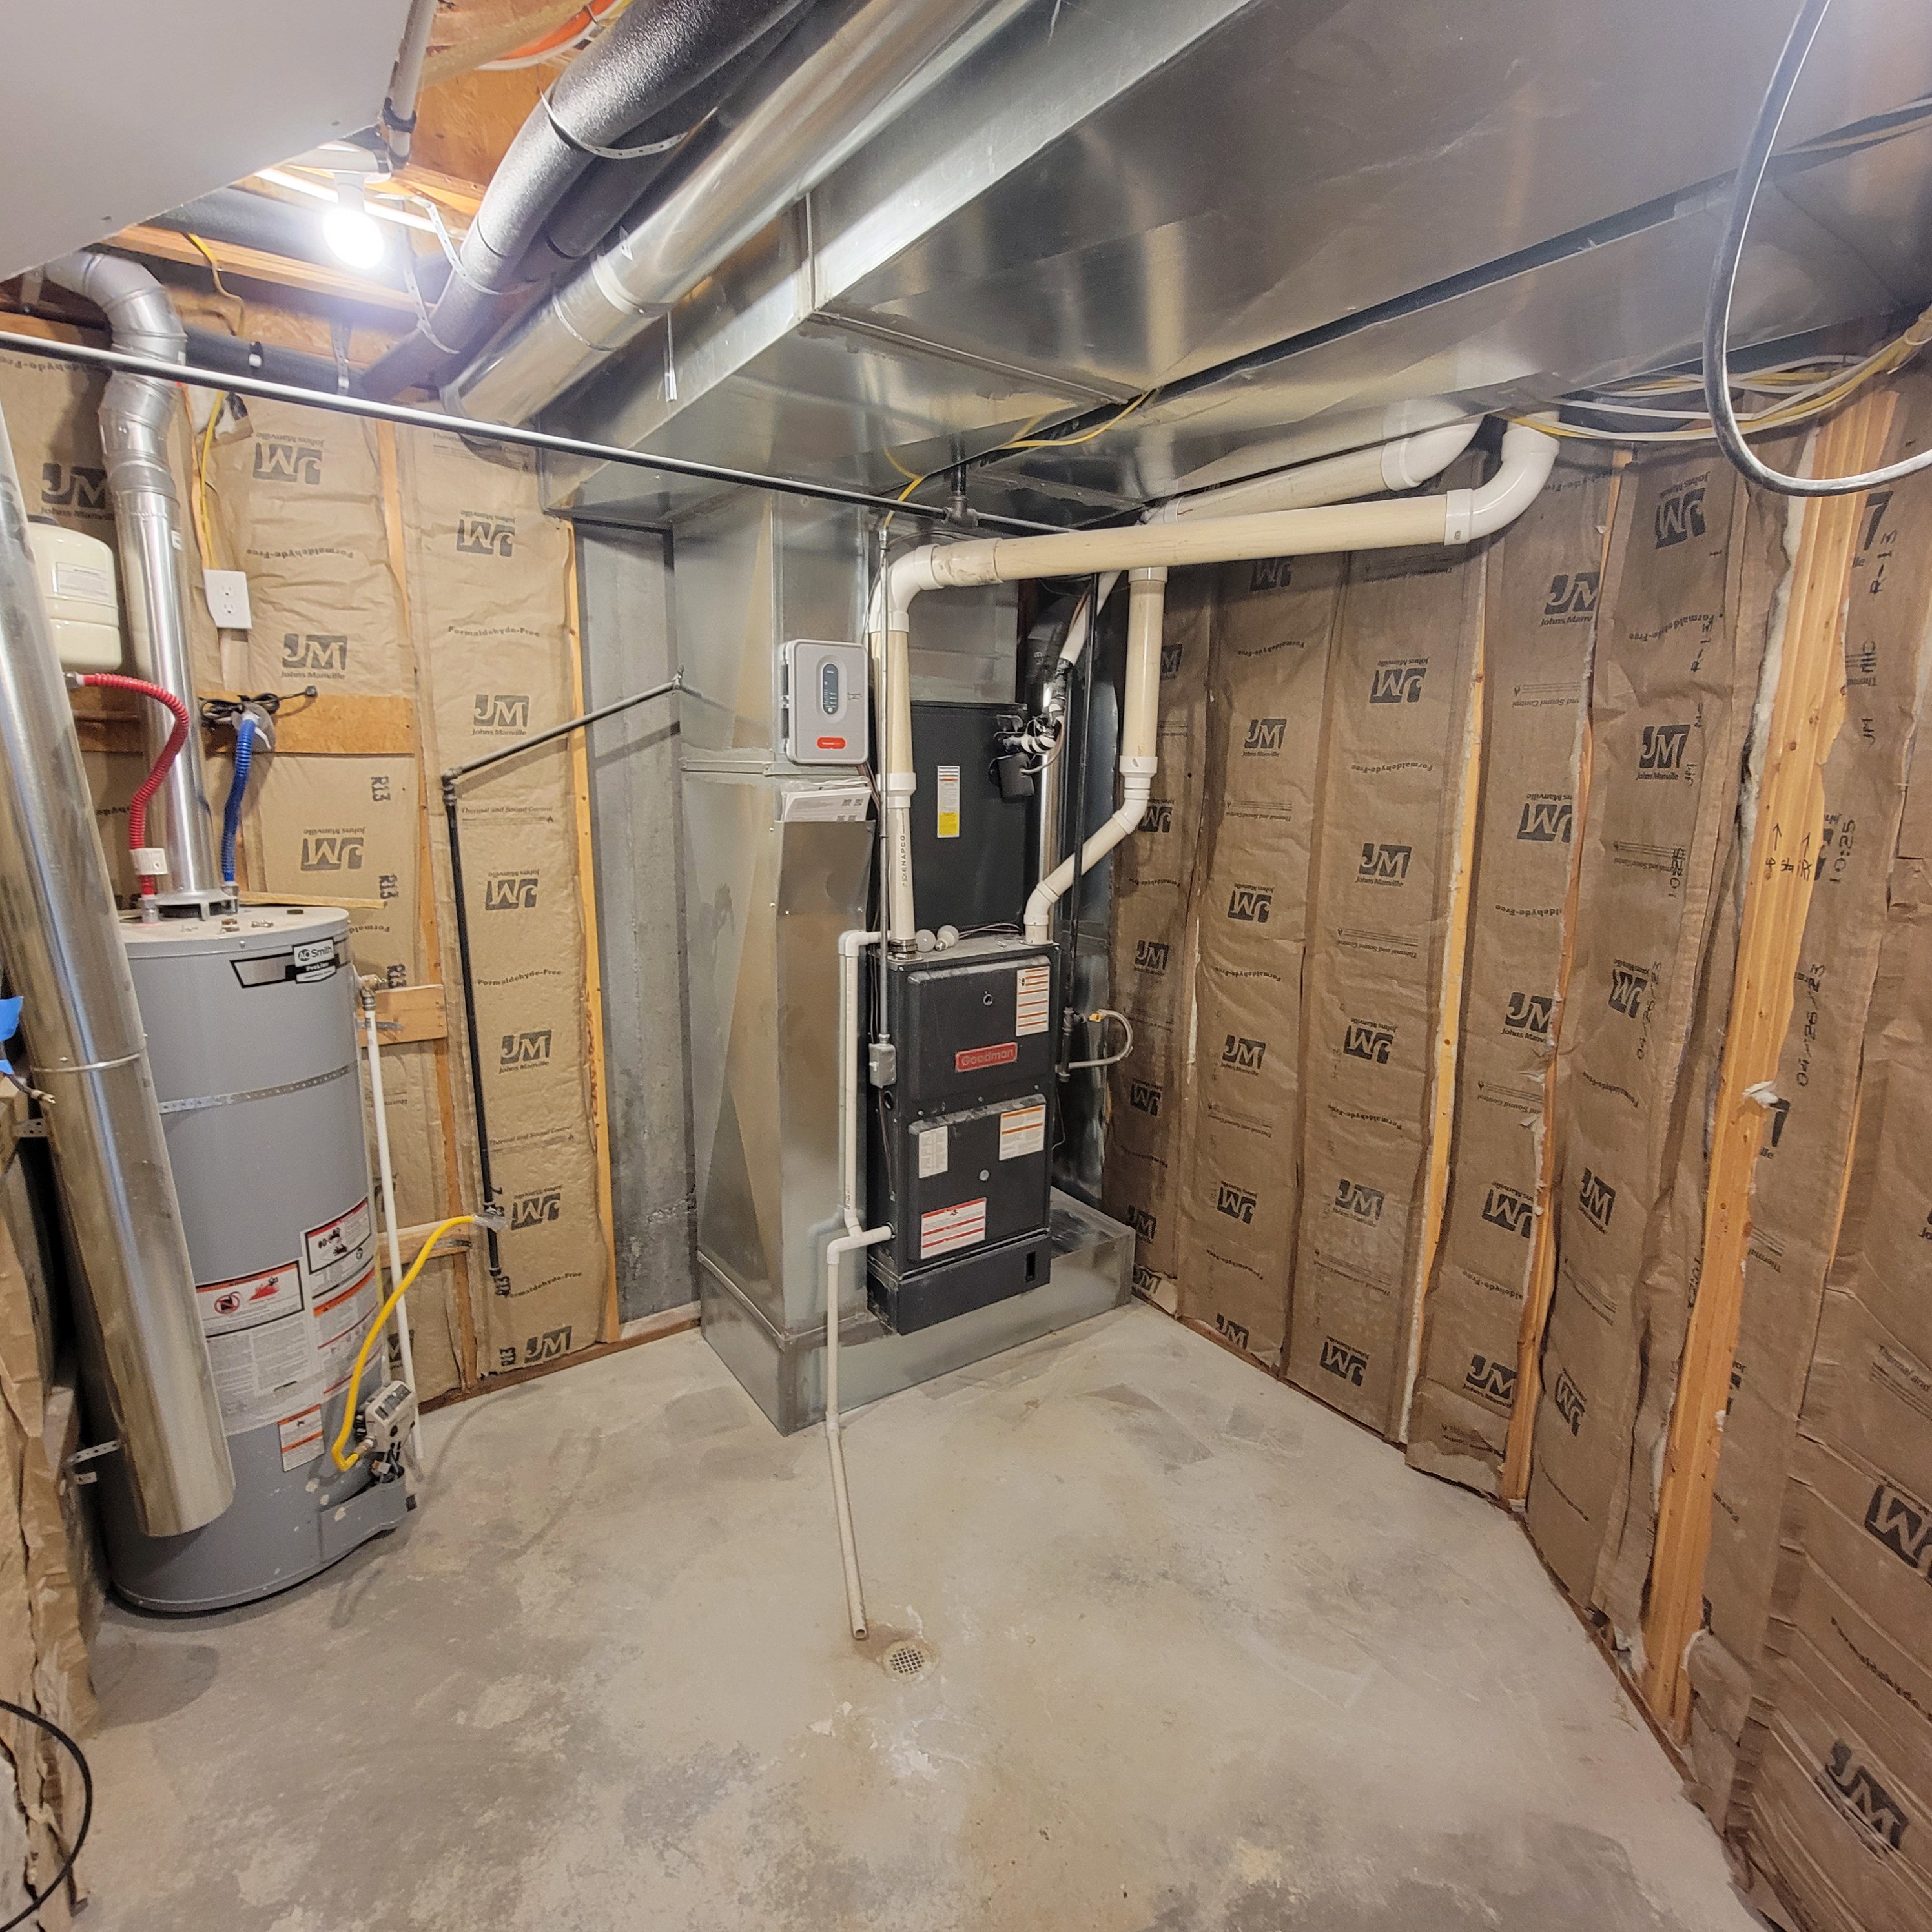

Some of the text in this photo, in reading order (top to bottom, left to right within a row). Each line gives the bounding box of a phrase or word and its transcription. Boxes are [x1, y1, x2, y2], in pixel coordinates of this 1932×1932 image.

[252, 442, 322, 485] JM
[1655, 487, 1707, 550] JM
[457, 519, 516, 557] JM
[1544, 571, 1600, 615] JM
[448, 626, 540, 637] Formaldehyde-Free
[1540, 616, 1566, 626] Johns
[282, 633, 348, 670] JM
[1369, 668, 1426, 703] JM
[1847, 677, 1878, 686] Therma
[473, 694, 529, 727] JM
[1540, 698, 1566, 707] Sound
[1244, 718, 1287, 750] JM
[1639, 724, 1691, 768] JM
[371, 776, 391, 802] R13
[300, 837, 364, 871] JM
[1359, 843, 1412, 878] JM
[379, 874, 399, 899] R13
[485, 878, 539, 910] JM
[1228, 890, 1272, 923] JM
[1495, 904, 1563, 917] ldehyde-Free
[1135, 940, 1169, 970] JM
[388, 963, 407, 988] R13
[478, 969, 562, 986] Formaldehyde-Free
[1505, 991, 1552, 1033] JM
[500, 1029, 553, 1065] JM
[961, 1049, 1014, 1066] Goodman
[1222, 1034, 1266, 1069] JM
[1344, 1025, 1393, 1064] JM
[511, 1193, 561, 1230] JM
[1217, 1185, 1256, 1224] JM
[1335, 1178, 1385, 1222] JM
[524, 1325, 572, 1364] JM
[1319, 1341, 1367, 1387] JM
[1466, 1354, 1517, 1400] JM
